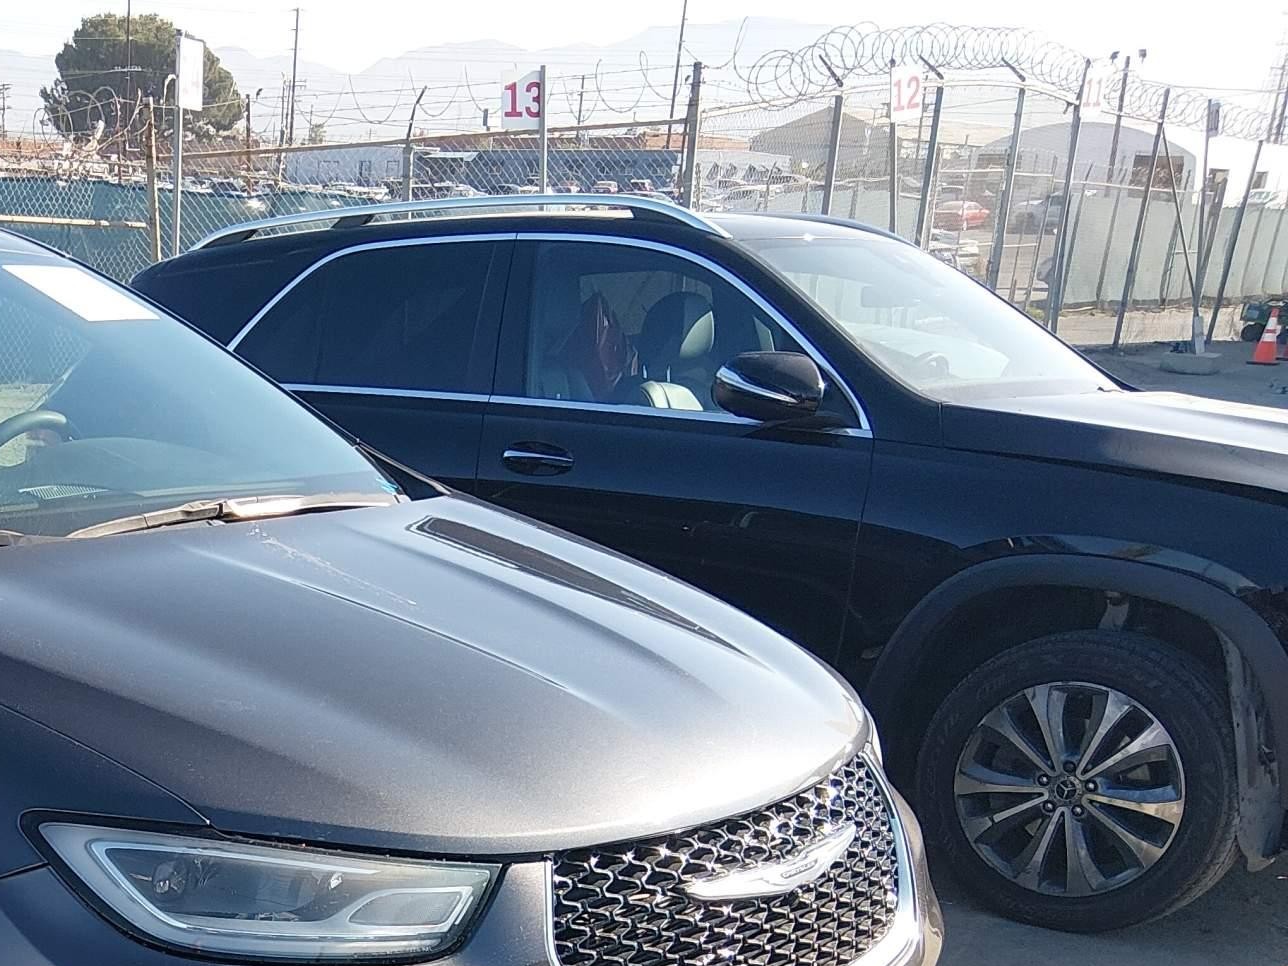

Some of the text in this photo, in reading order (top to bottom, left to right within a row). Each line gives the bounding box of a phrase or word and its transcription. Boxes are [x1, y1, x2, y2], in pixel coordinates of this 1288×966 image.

[504, 81, 541, 118] 13
[893, 76, 920, 112] 12
[1083, 78, 1103, 108] 11
